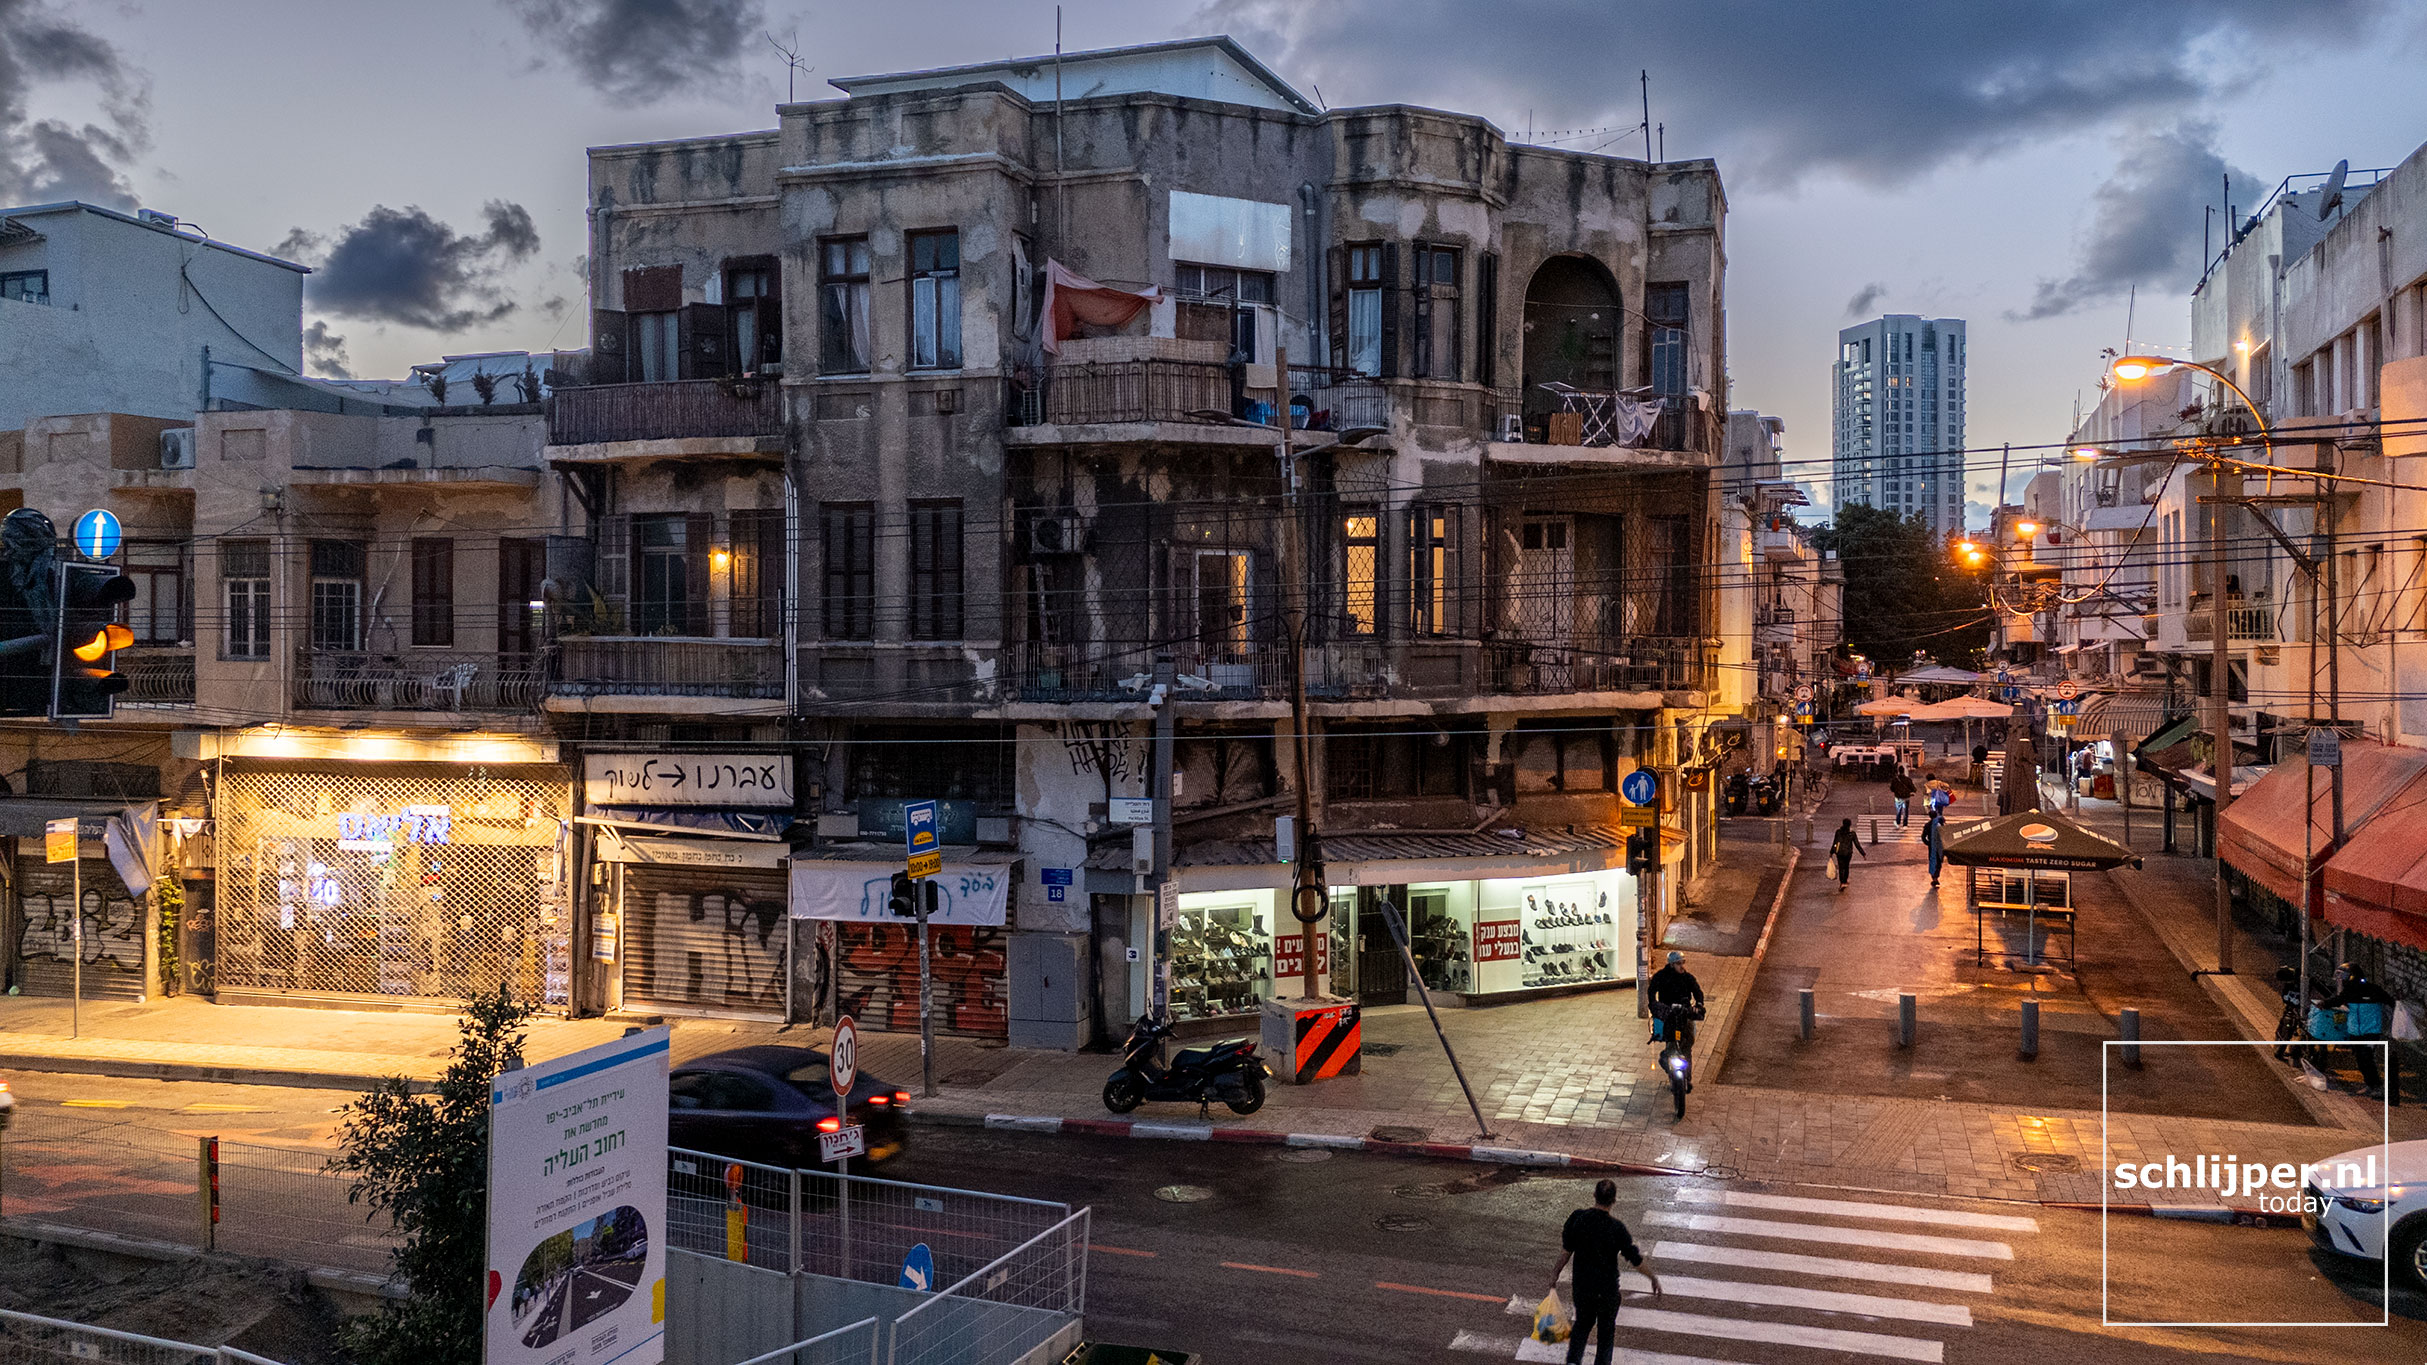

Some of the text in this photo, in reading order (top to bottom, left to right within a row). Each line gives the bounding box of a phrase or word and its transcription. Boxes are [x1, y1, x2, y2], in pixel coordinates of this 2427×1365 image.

[604, 759, 776, 799] עברנו לשוק
[1989, 856, 2097, 868] MAXIMUM TASTE ZERO SUGAR
[1050, 889, 1062, 898] 18
[1480, 925, 1496, 942] ענק
[1497, 923, 1519, 938] מבצע
[1284, 937, 1325, 954] מעים
[1494, 940, 1519, 956] בנעלי
[1276, 953, 1326, 973] לגים
[837, 1037, 854, 1073] 30
[601, 1088, 625, 1104] עיריית
[564, 1116, 608, 1140] מחדשת את
[543, 1130, 625, 1177] רחוב העליה
